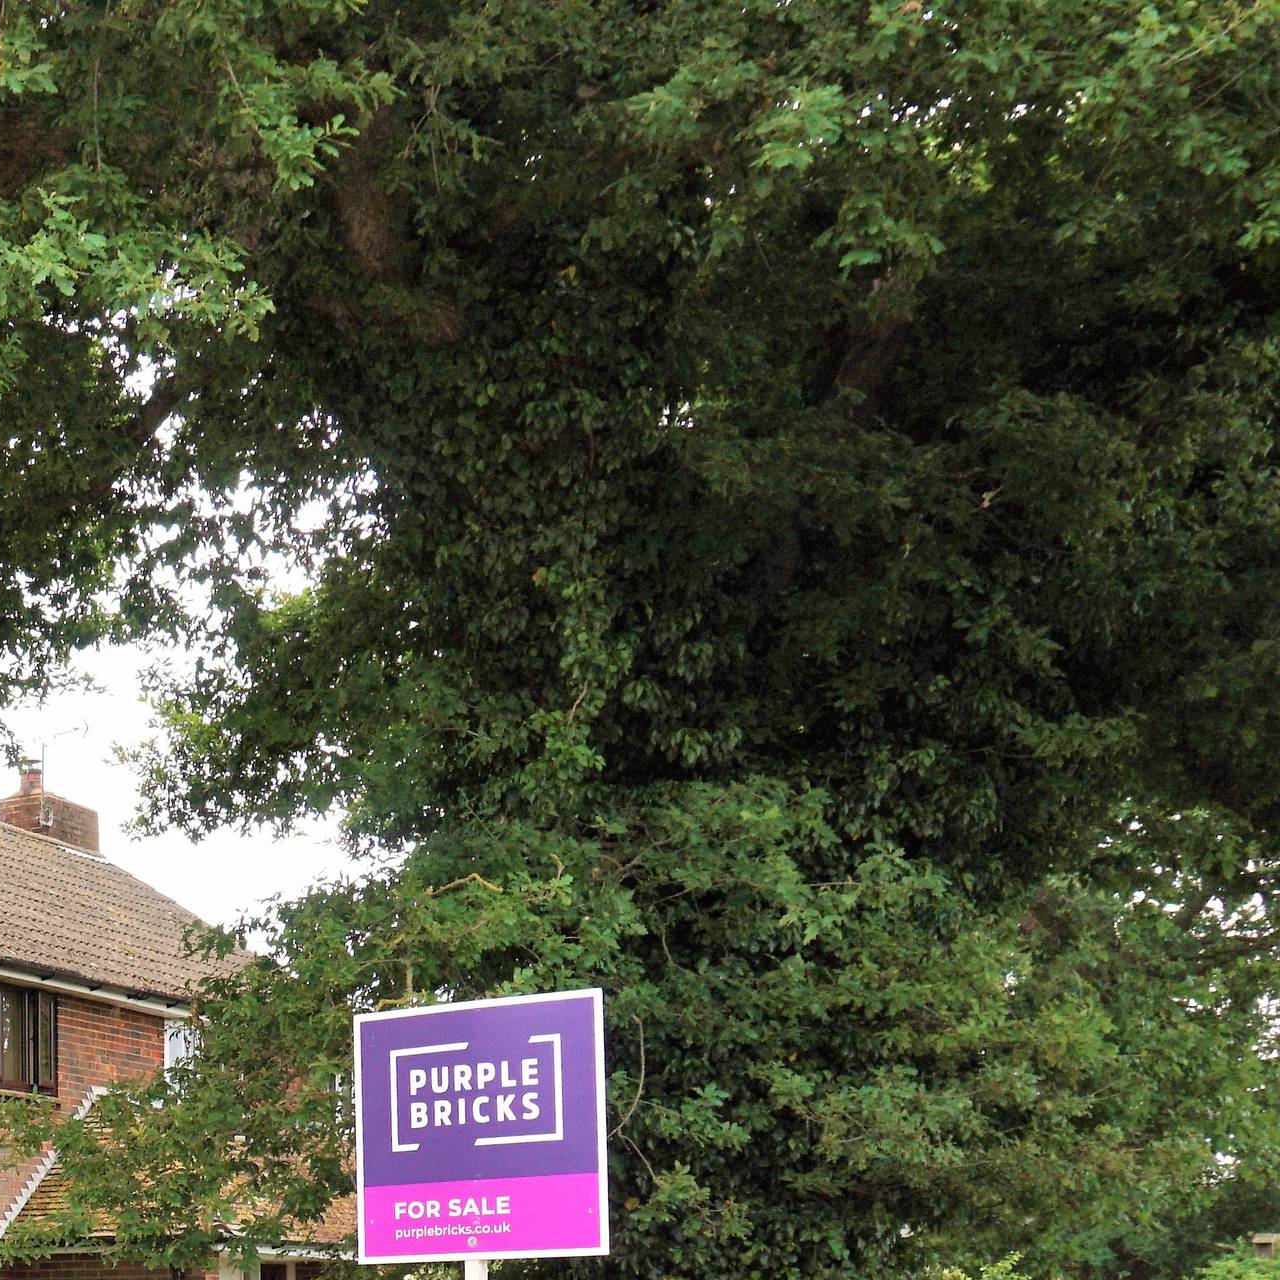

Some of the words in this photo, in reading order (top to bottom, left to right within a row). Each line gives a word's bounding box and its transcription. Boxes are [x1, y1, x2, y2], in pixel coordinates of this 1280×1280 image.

[409, 1058, 539, 1096] PURPLE
[410, 1092, 540, 1129] BRICKS
[394, 1200, 441, 1220] FOR
[448, 1196, 511, 1217] SALE
[395, 1221, 511, 1241] purplebricks.co.uk
